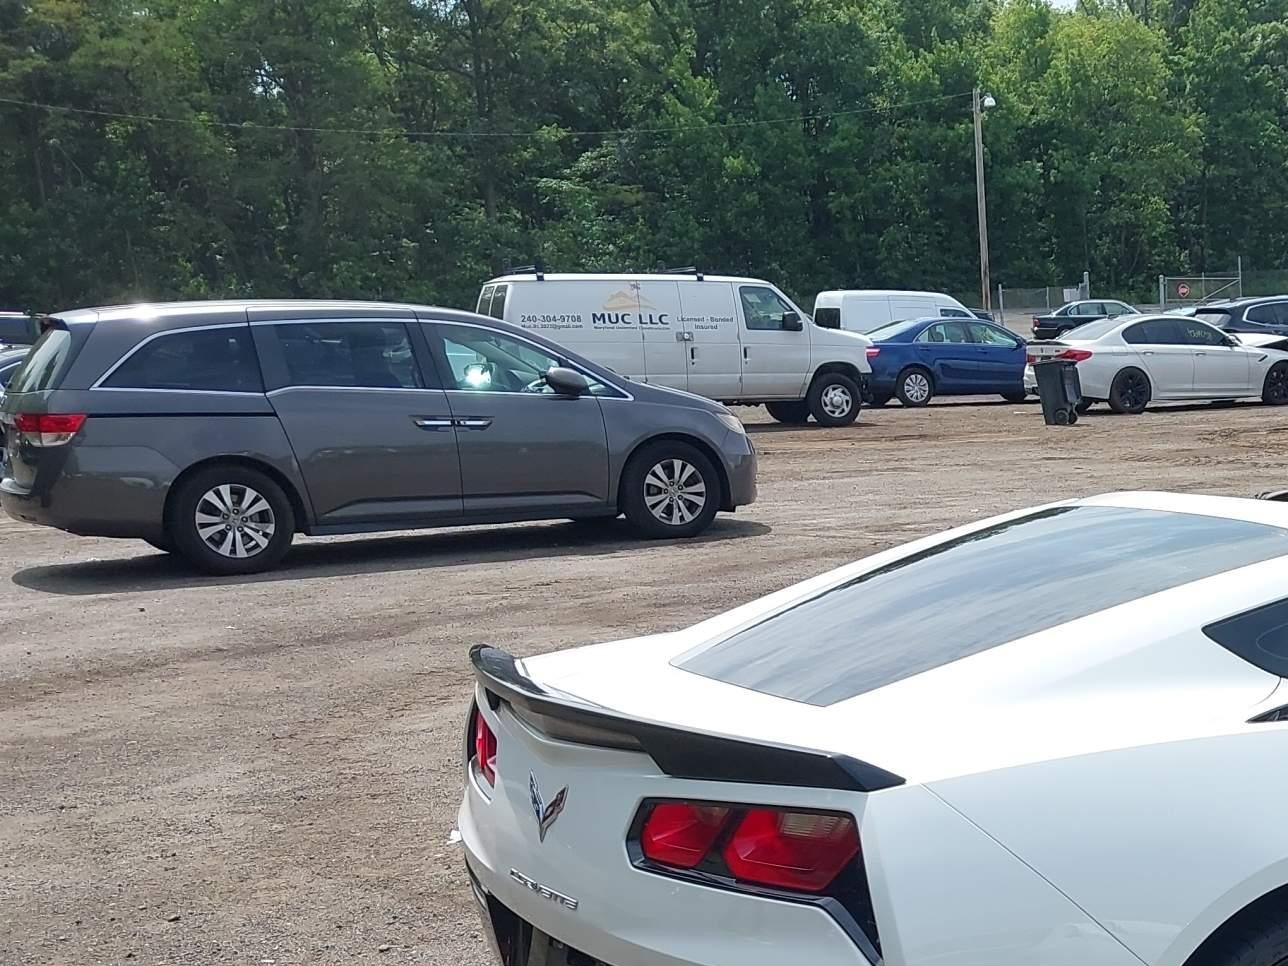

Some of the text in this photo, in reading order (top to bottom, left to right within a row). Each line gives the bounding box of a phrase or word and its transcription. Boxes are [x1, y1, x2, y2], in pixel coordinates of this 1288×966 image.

[520, 314, 582, 323] 240-304-9708
[591, 313, 670, 325] MUC LLC
